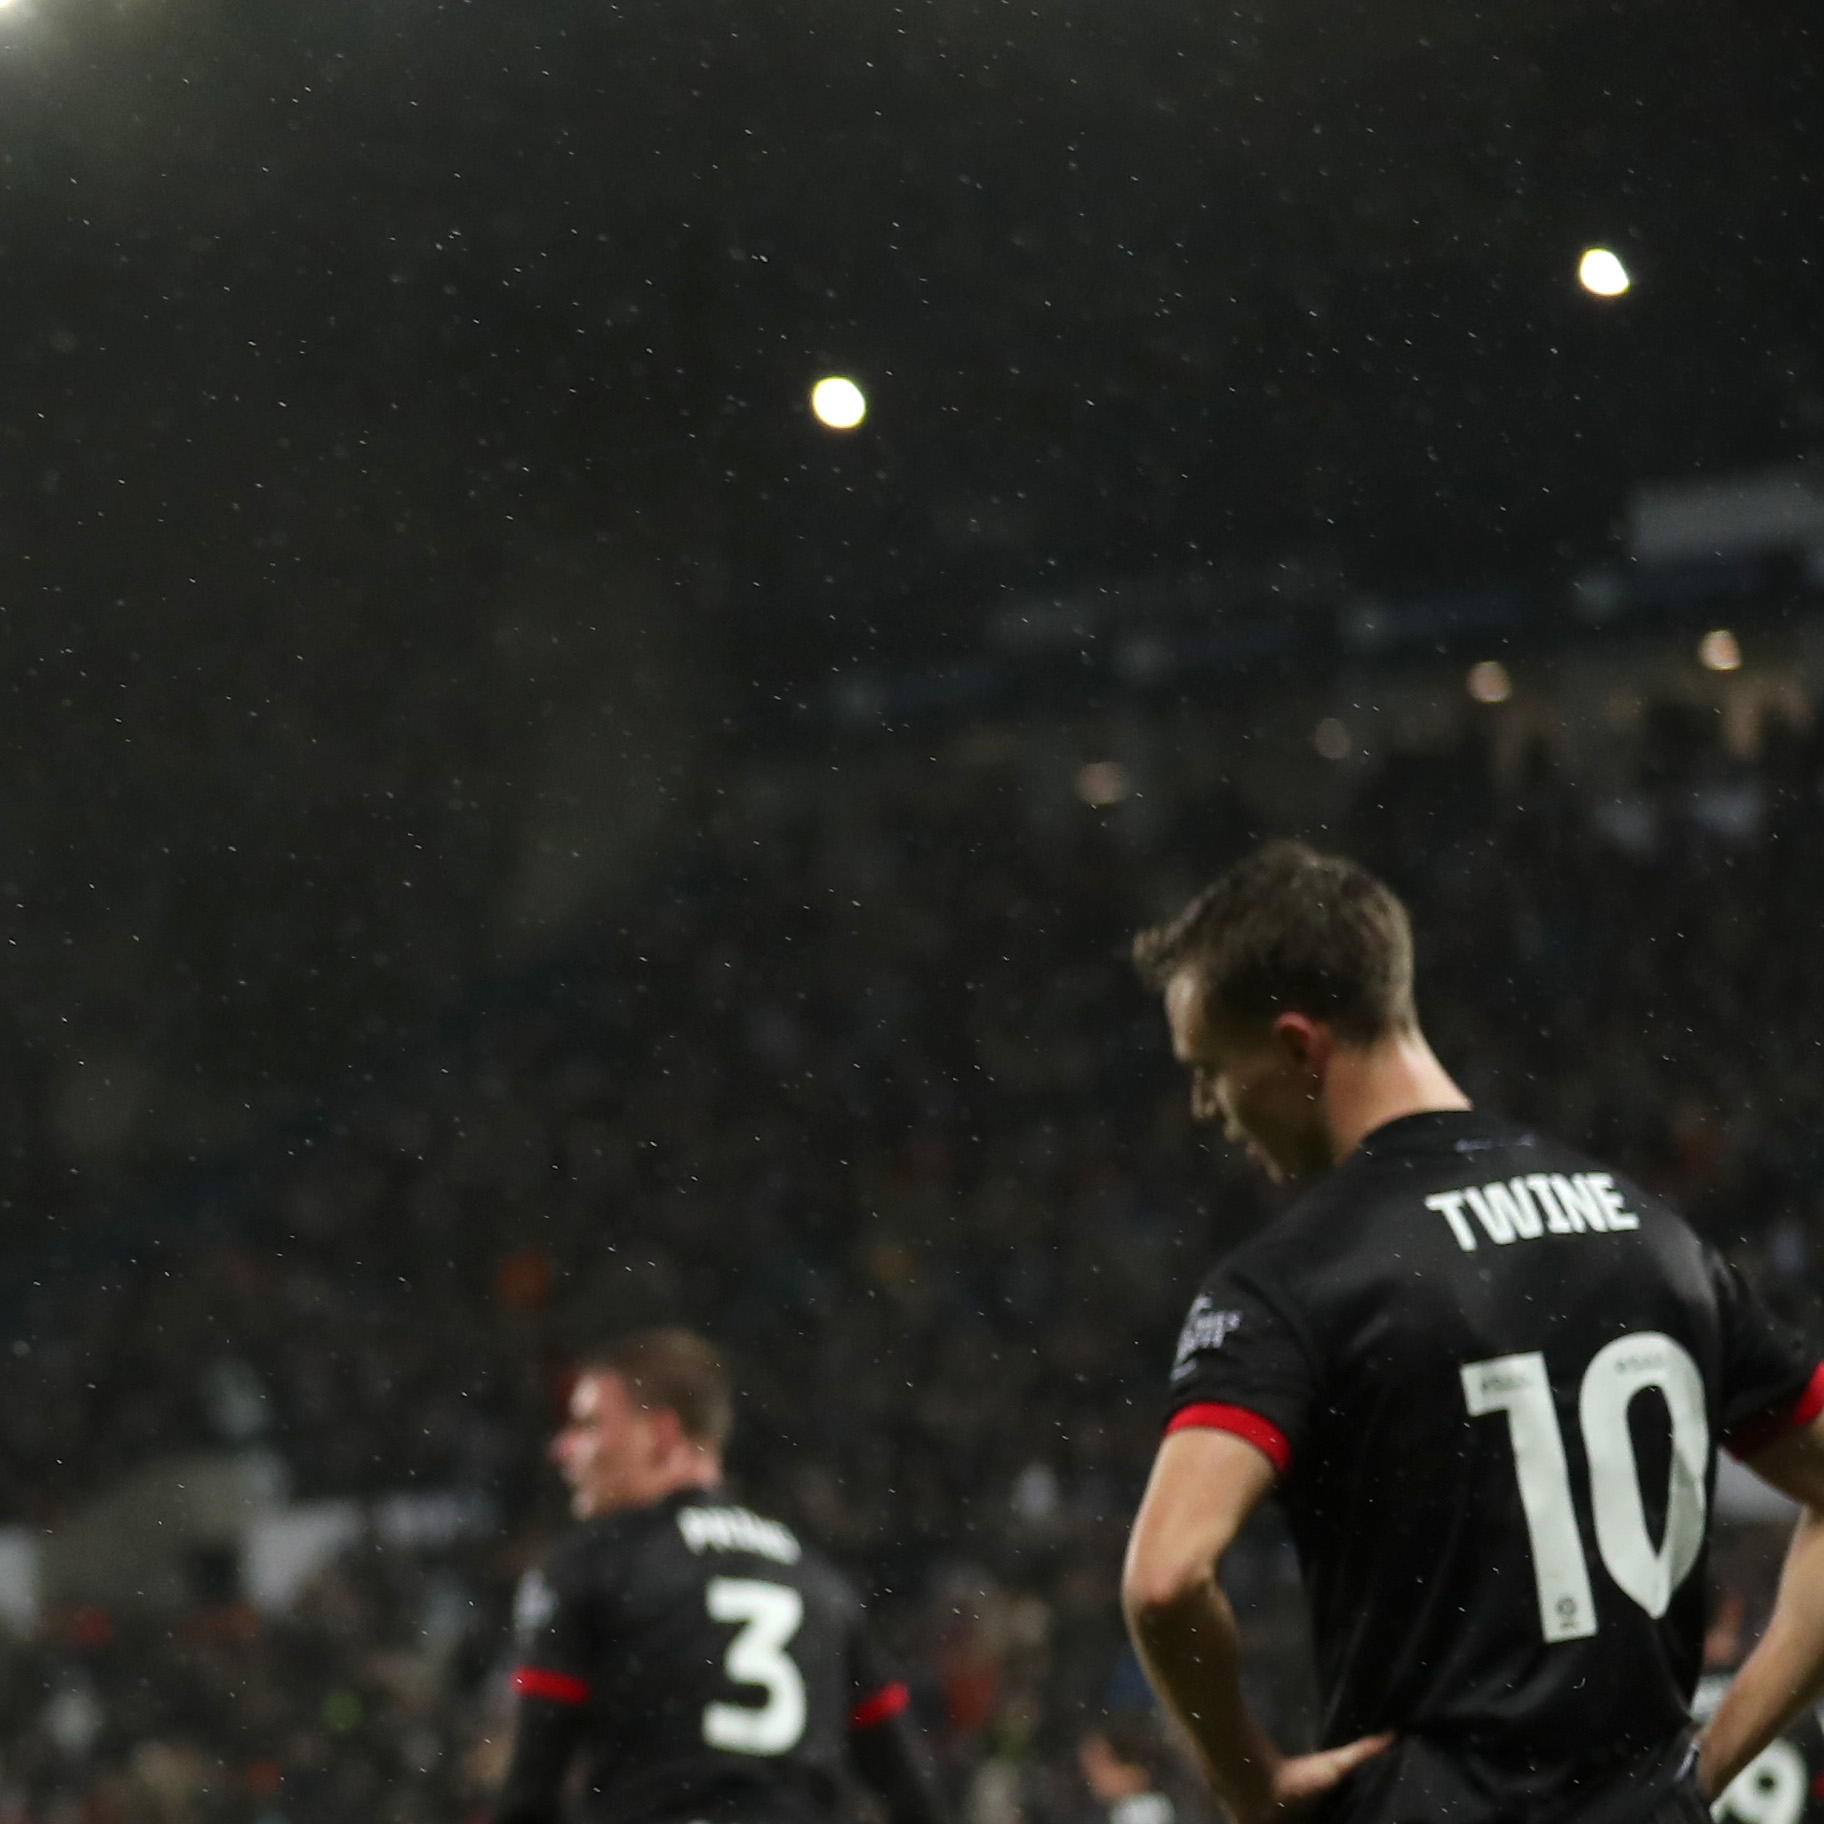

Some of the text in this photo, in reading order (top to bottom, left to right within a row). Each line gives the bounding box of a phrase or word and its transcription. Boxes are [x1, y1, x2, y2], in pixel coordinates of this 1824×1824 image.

[1424, 1172, 1640, 1251] TWINE
[1460, 1331, 1709, 1643] 10
[702, 1576, 807, 1757] 3
